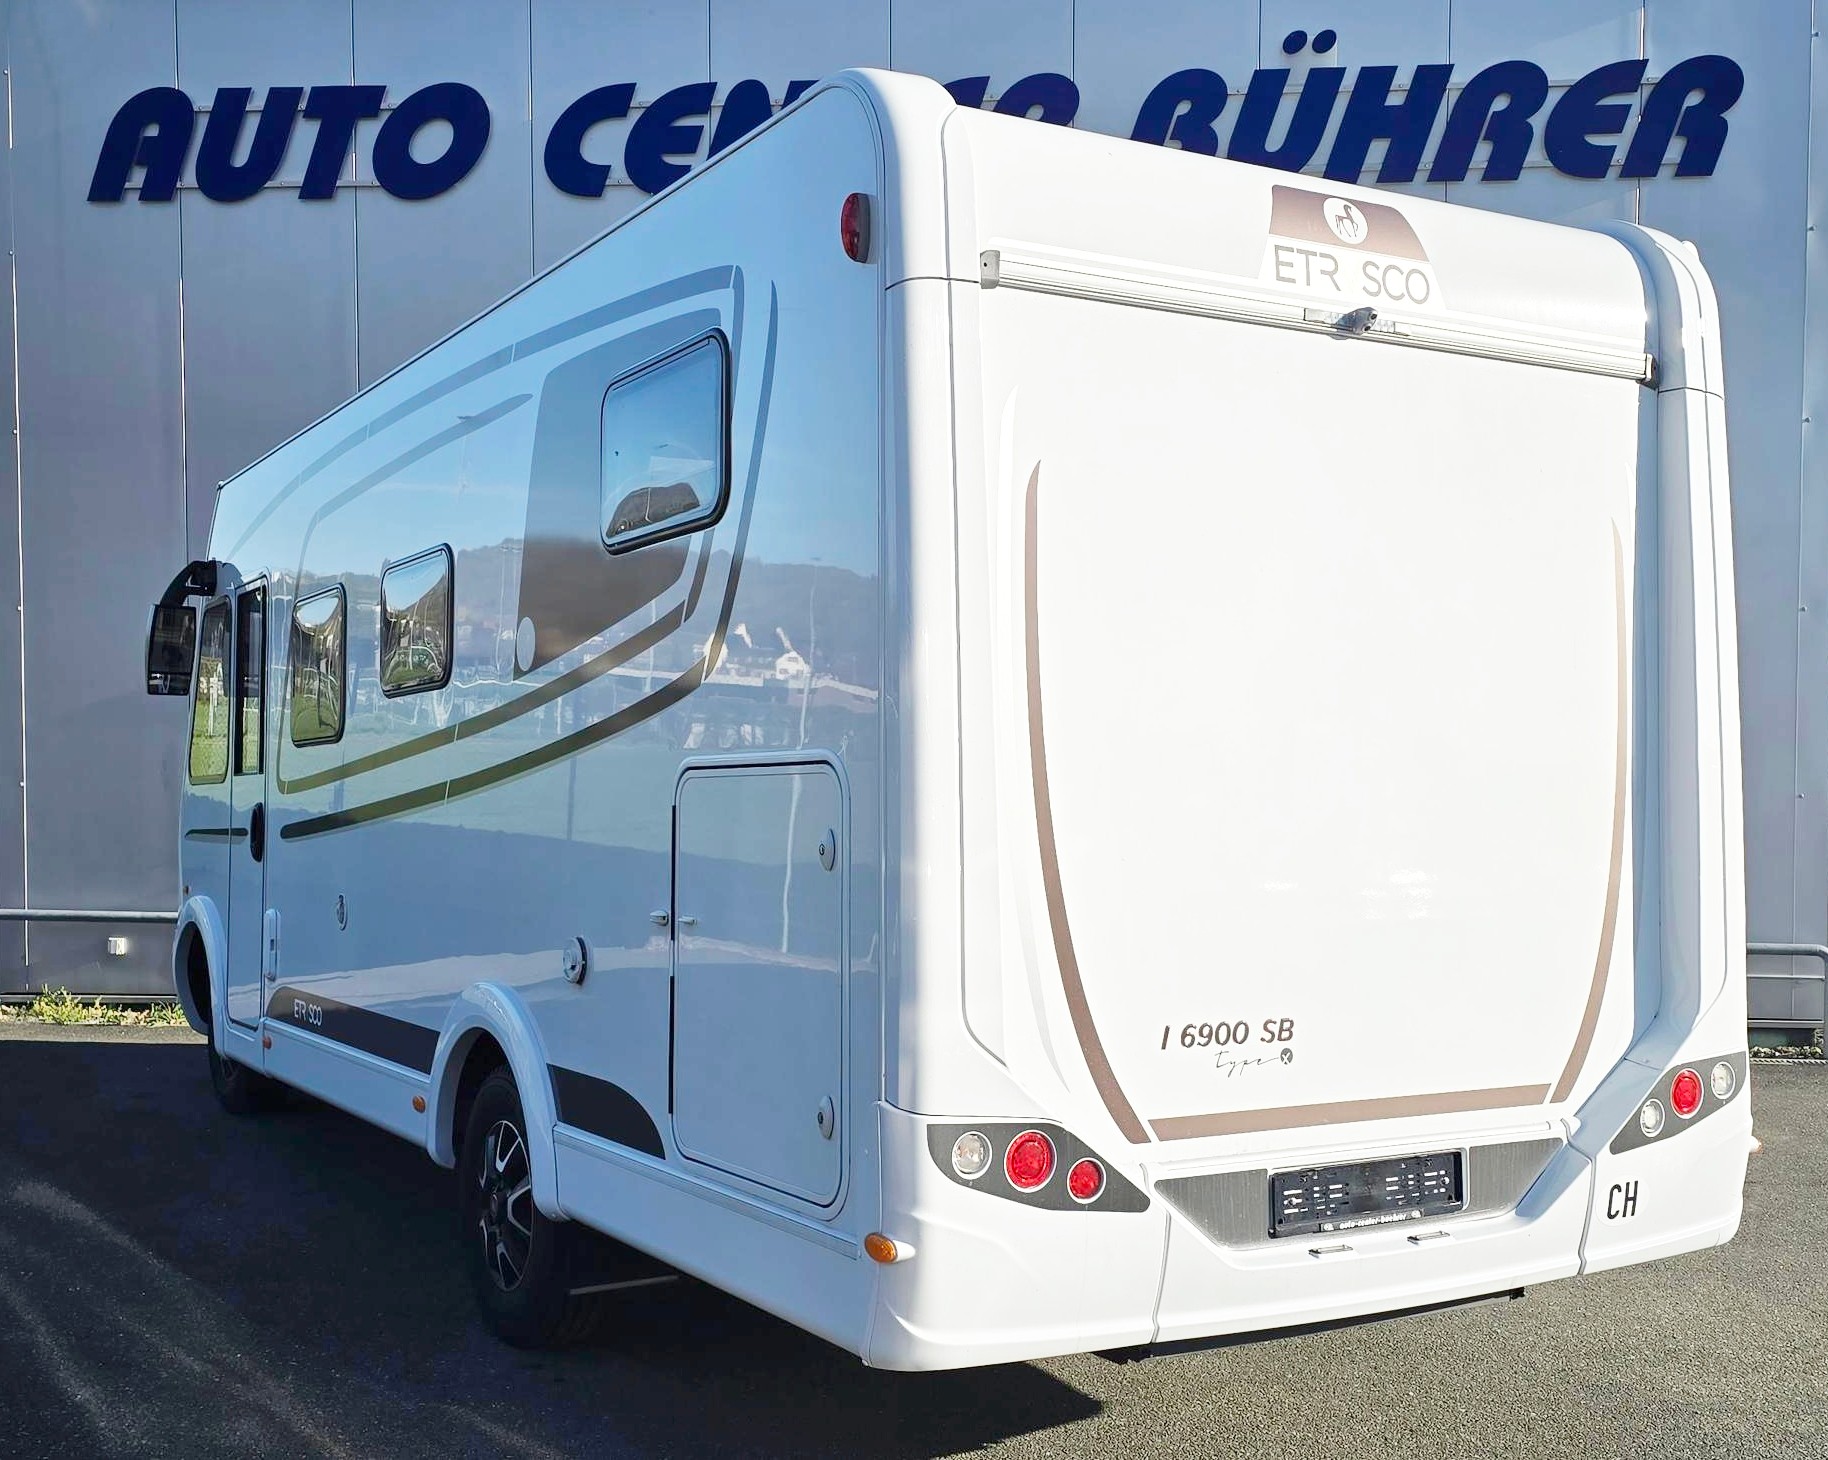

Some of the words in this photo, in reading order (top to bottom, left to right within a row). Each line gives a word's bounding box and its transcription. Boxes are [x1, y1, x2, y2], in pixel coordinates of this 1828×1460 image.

[88, 82, 491, 202] AUTO
[1130, 29, 1745, 183] BÜHRER
[1180, 1020, 1250, 1048] 6900
[1260, 1017, 1295, 1043] SB
[1606, 1180, 1639, 1220] CH
